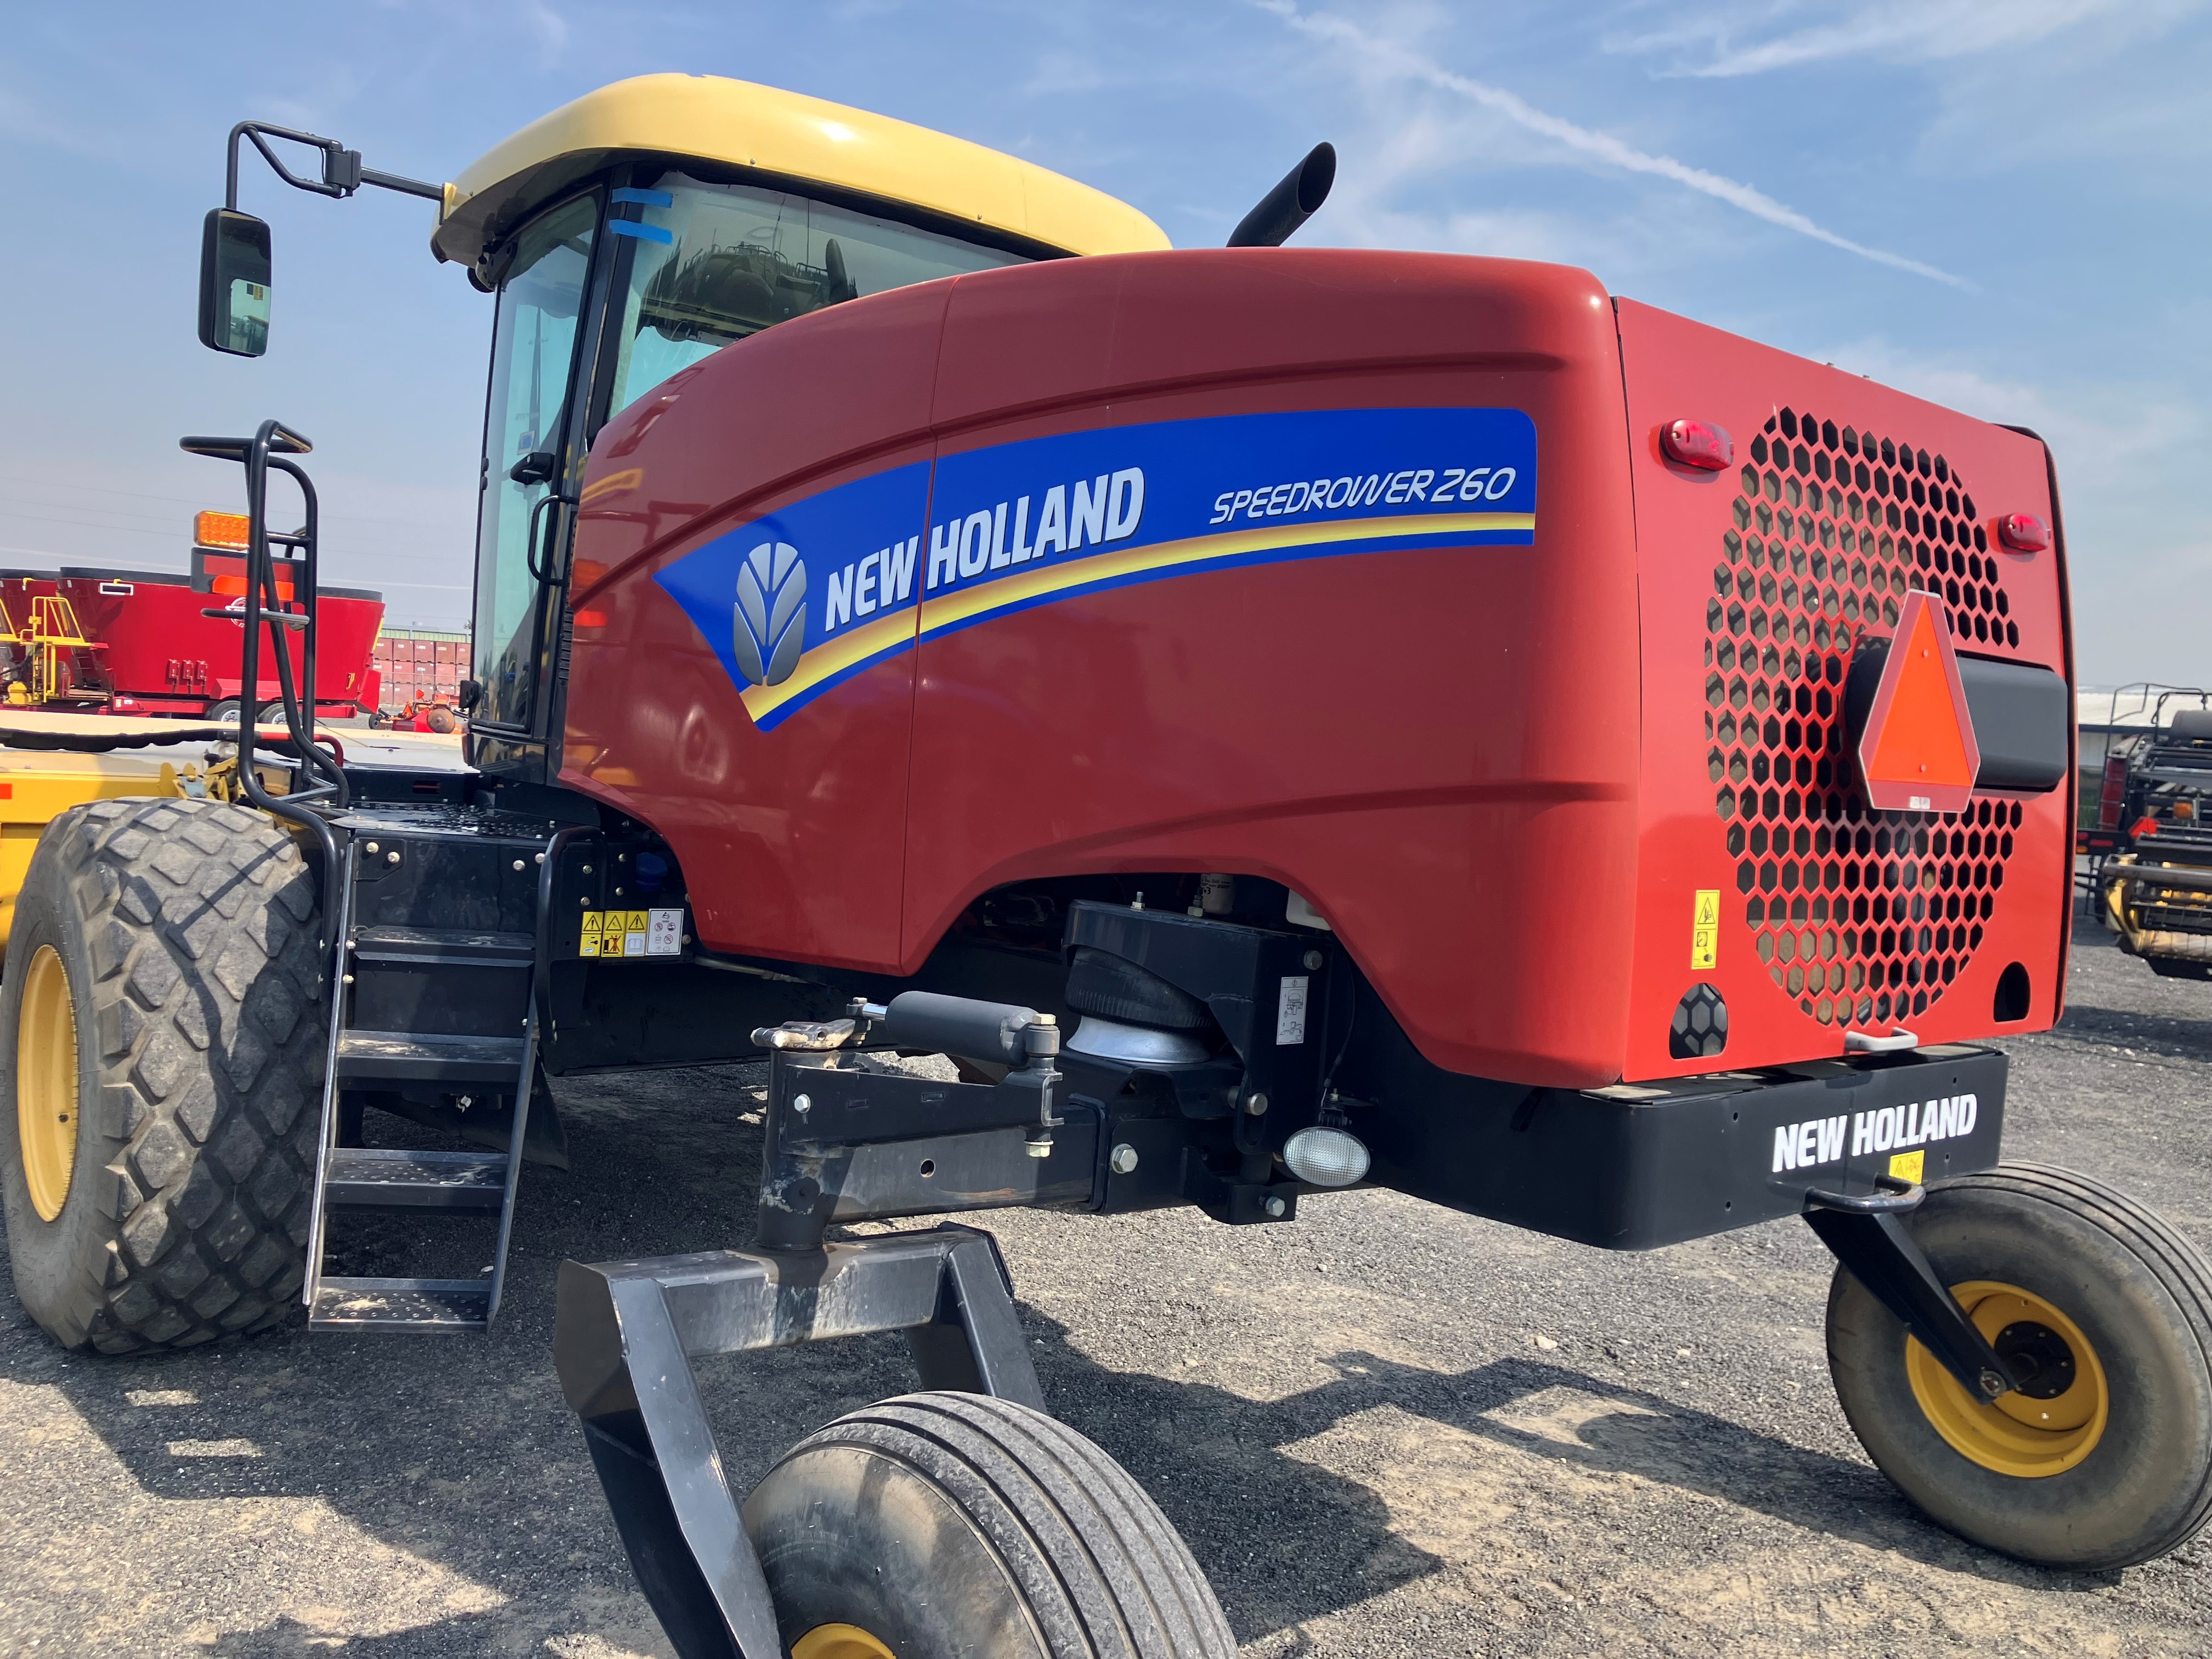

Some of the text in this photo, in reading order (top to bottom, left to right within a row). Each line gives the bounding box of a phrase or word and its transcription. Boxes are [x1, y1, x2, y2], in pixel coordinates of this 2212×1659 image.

[1209, 467, 1516, 524] SPEEDROWER 260
[826, 467, 1146, 632] NEW HOLLAND
[1772, 1093, 1977, 1172] NEW HOLLAND
